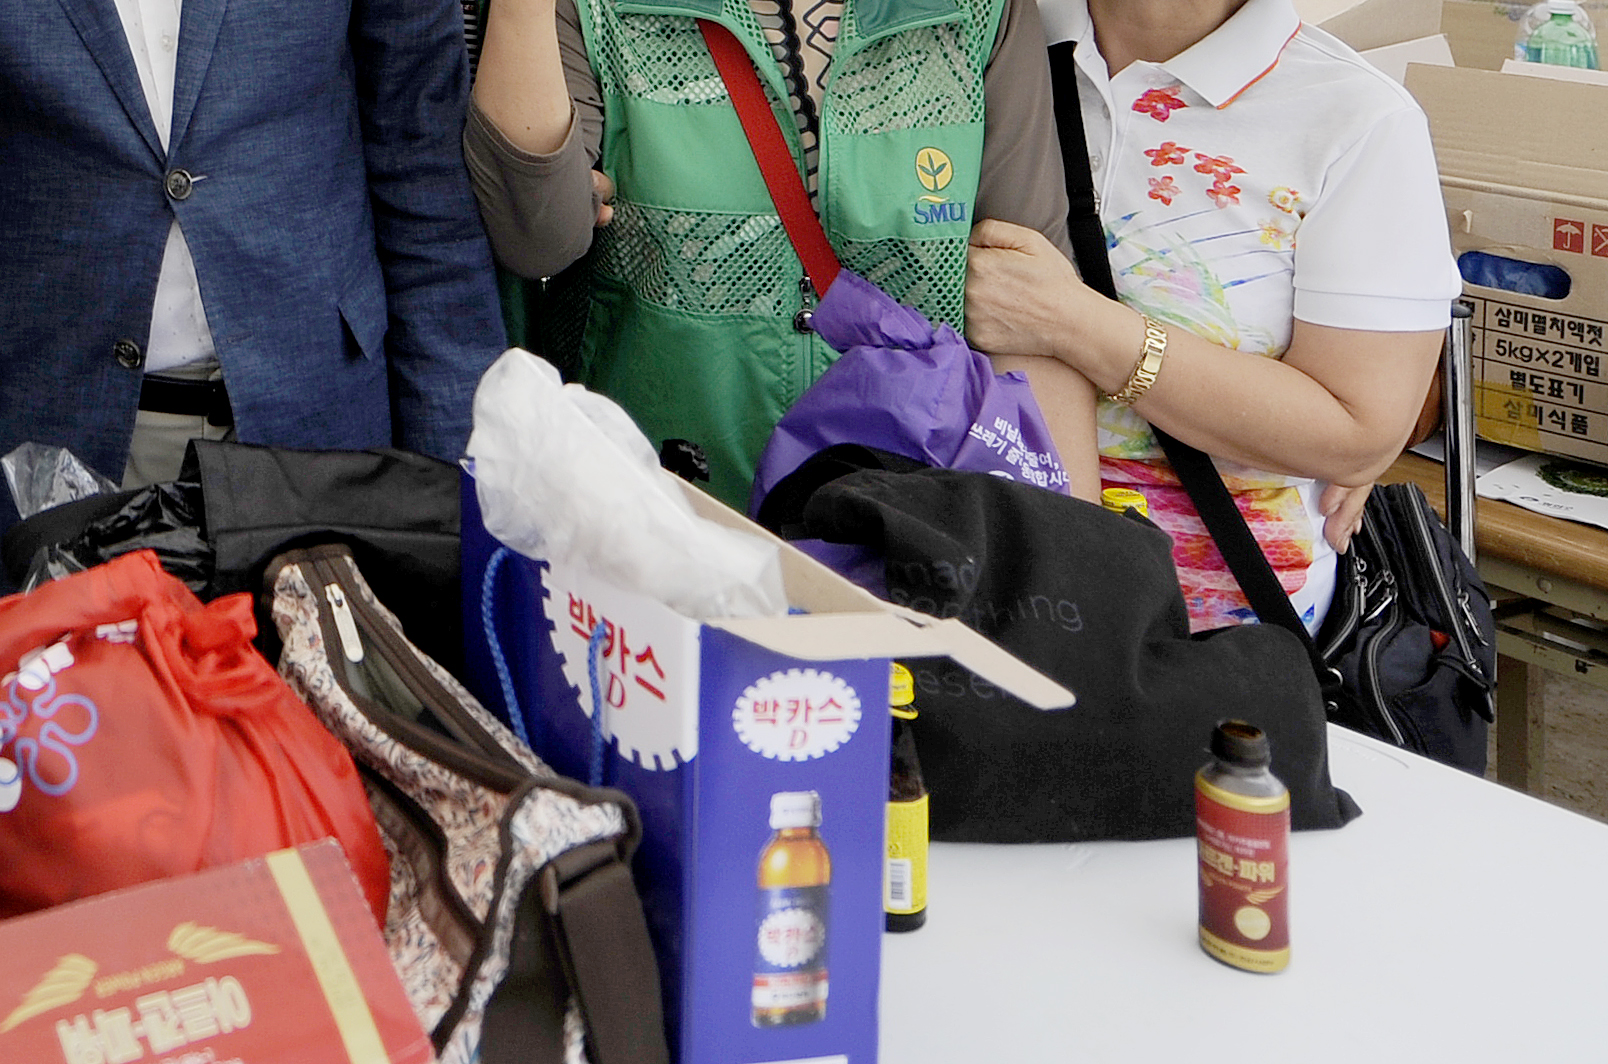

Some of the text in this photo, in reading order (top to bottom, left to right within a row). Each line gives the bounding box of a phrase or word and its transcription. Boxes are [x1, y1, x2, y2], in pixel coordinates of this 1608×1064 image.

[913, 202, 967, 225] SMU
[1495, 306, 1603, 347] 삼미멸치액젓
[1509, 369, 1584, 405] 별도표기
[1503, 398, 1589, 435] 삼미식품
[568, 591, 666, 702] 박카스
[607, 671, 627, 709] D
[752, 697, 843, 725] 박카스
[789, 729, 809, 749] D
